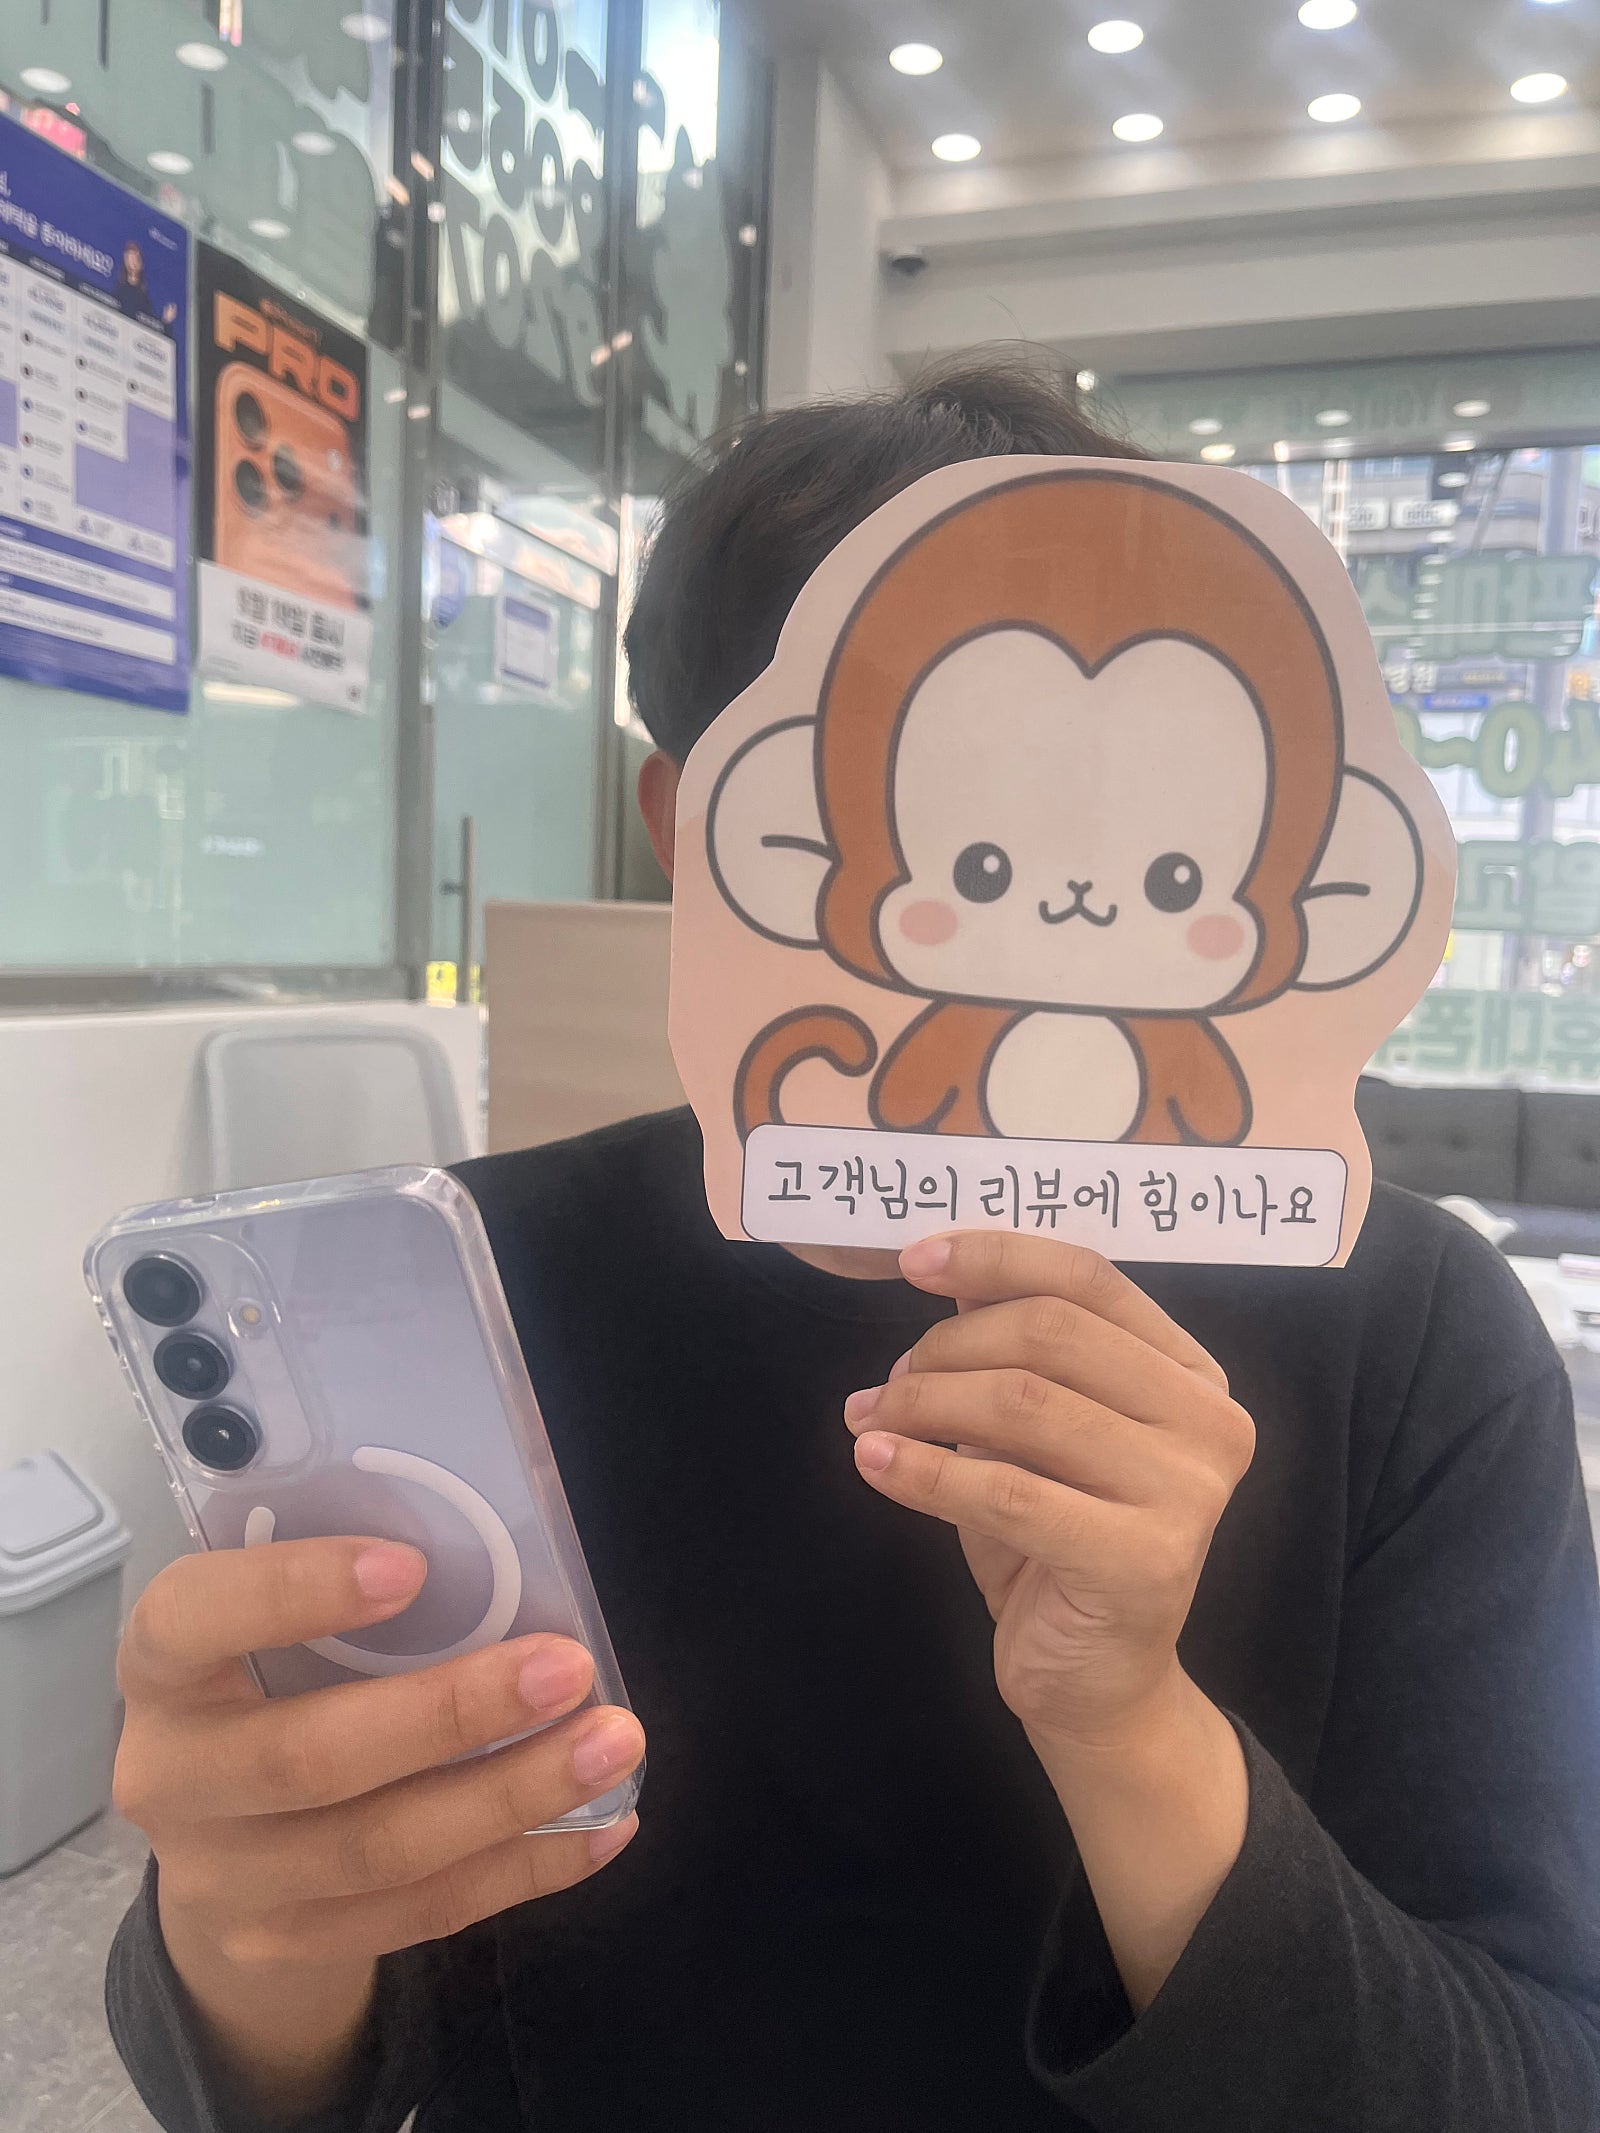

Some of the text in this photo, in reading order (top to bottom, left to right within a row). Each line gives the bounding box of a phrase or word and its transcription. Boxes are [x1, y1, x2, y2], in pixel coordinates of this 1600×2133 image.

[213, 288, 361, 422] PRO
[767, 1154, 1318, 1236] 고객님의 리뷰에 힘이나요
